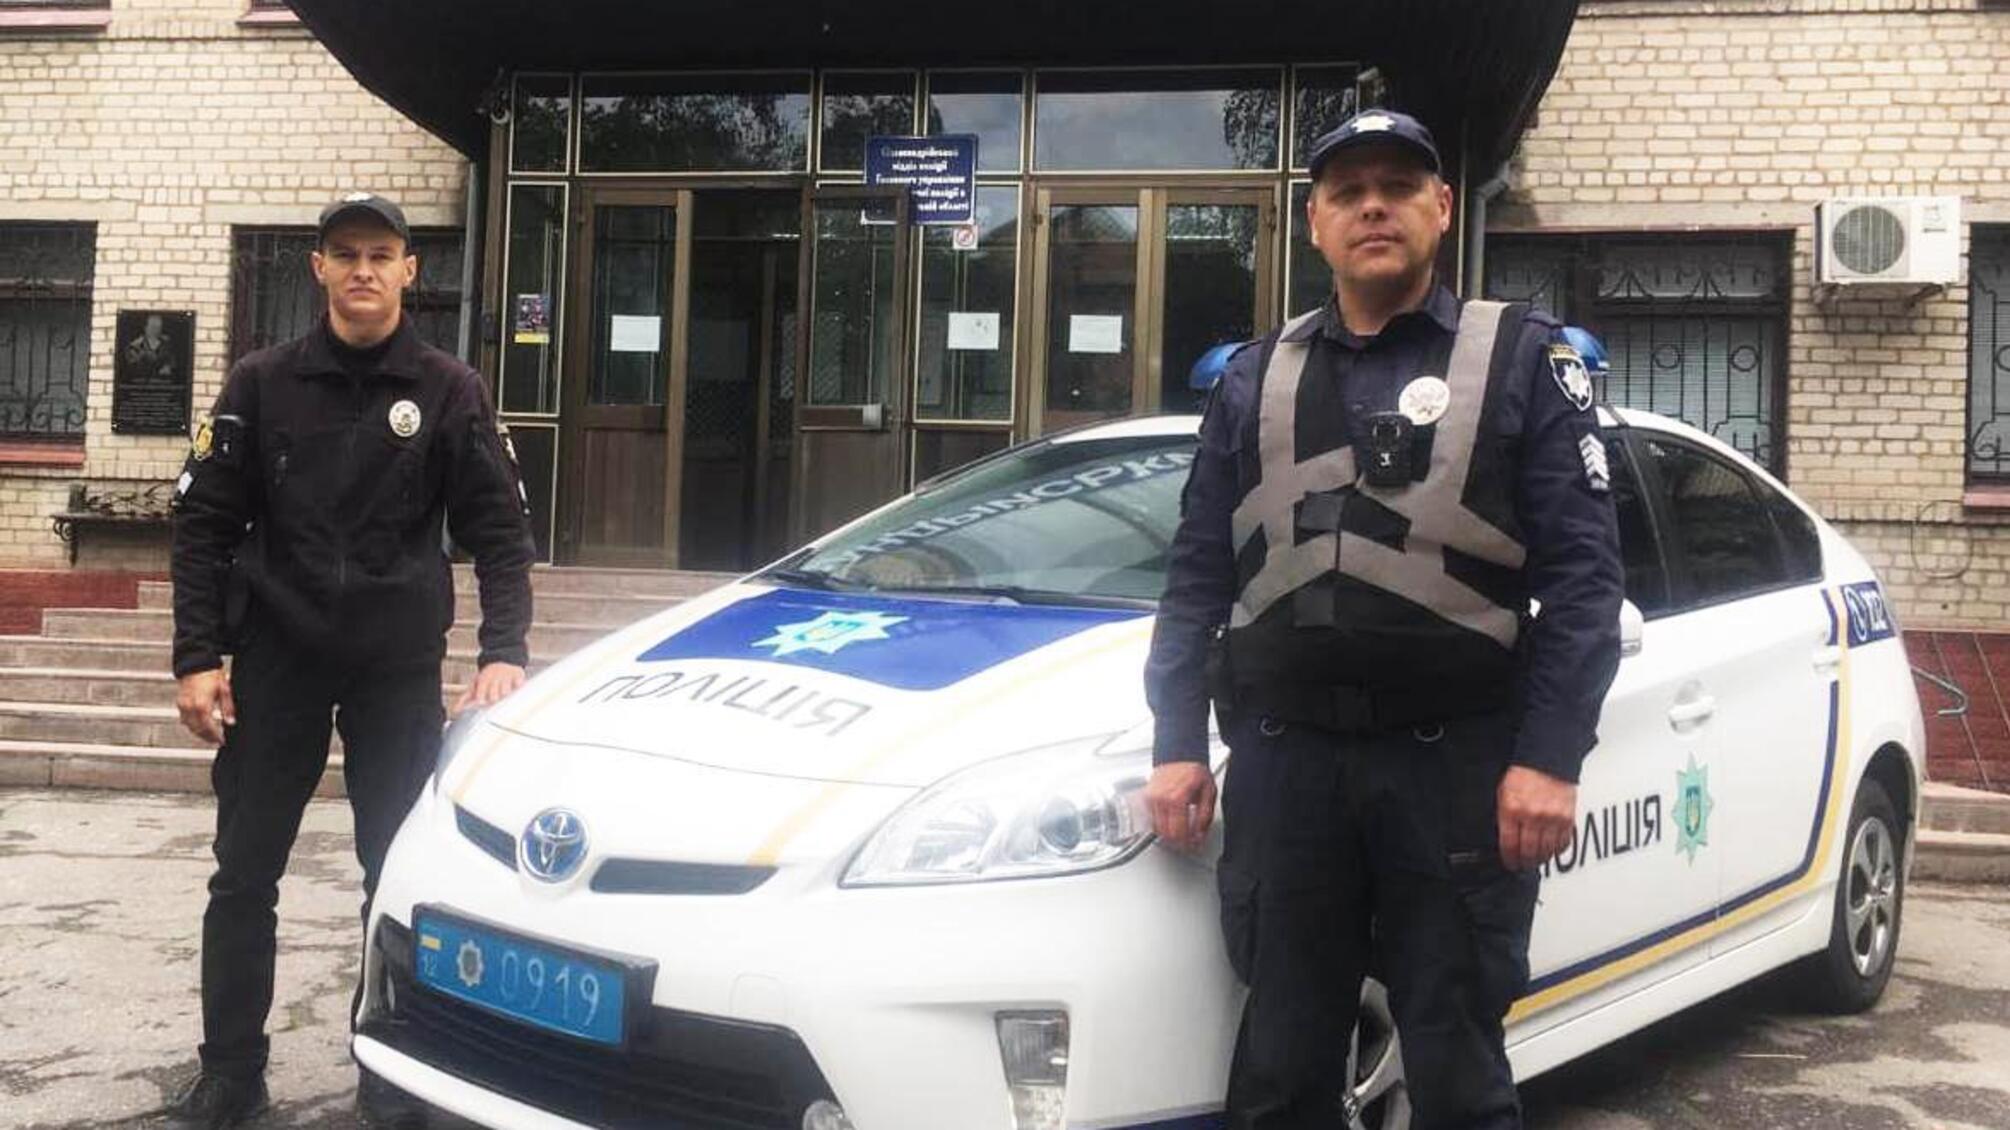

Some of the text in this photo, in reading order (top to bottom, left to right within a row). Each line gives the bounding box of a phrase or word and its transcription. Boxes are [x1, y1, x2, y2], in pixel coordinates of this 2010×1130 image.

[577, 671, 873, 737] ПОЛІЦІЯ
[1538, 794, 1661, 878] ОЛІЦІЯ
[502, 950, 600, 1027] 0919
